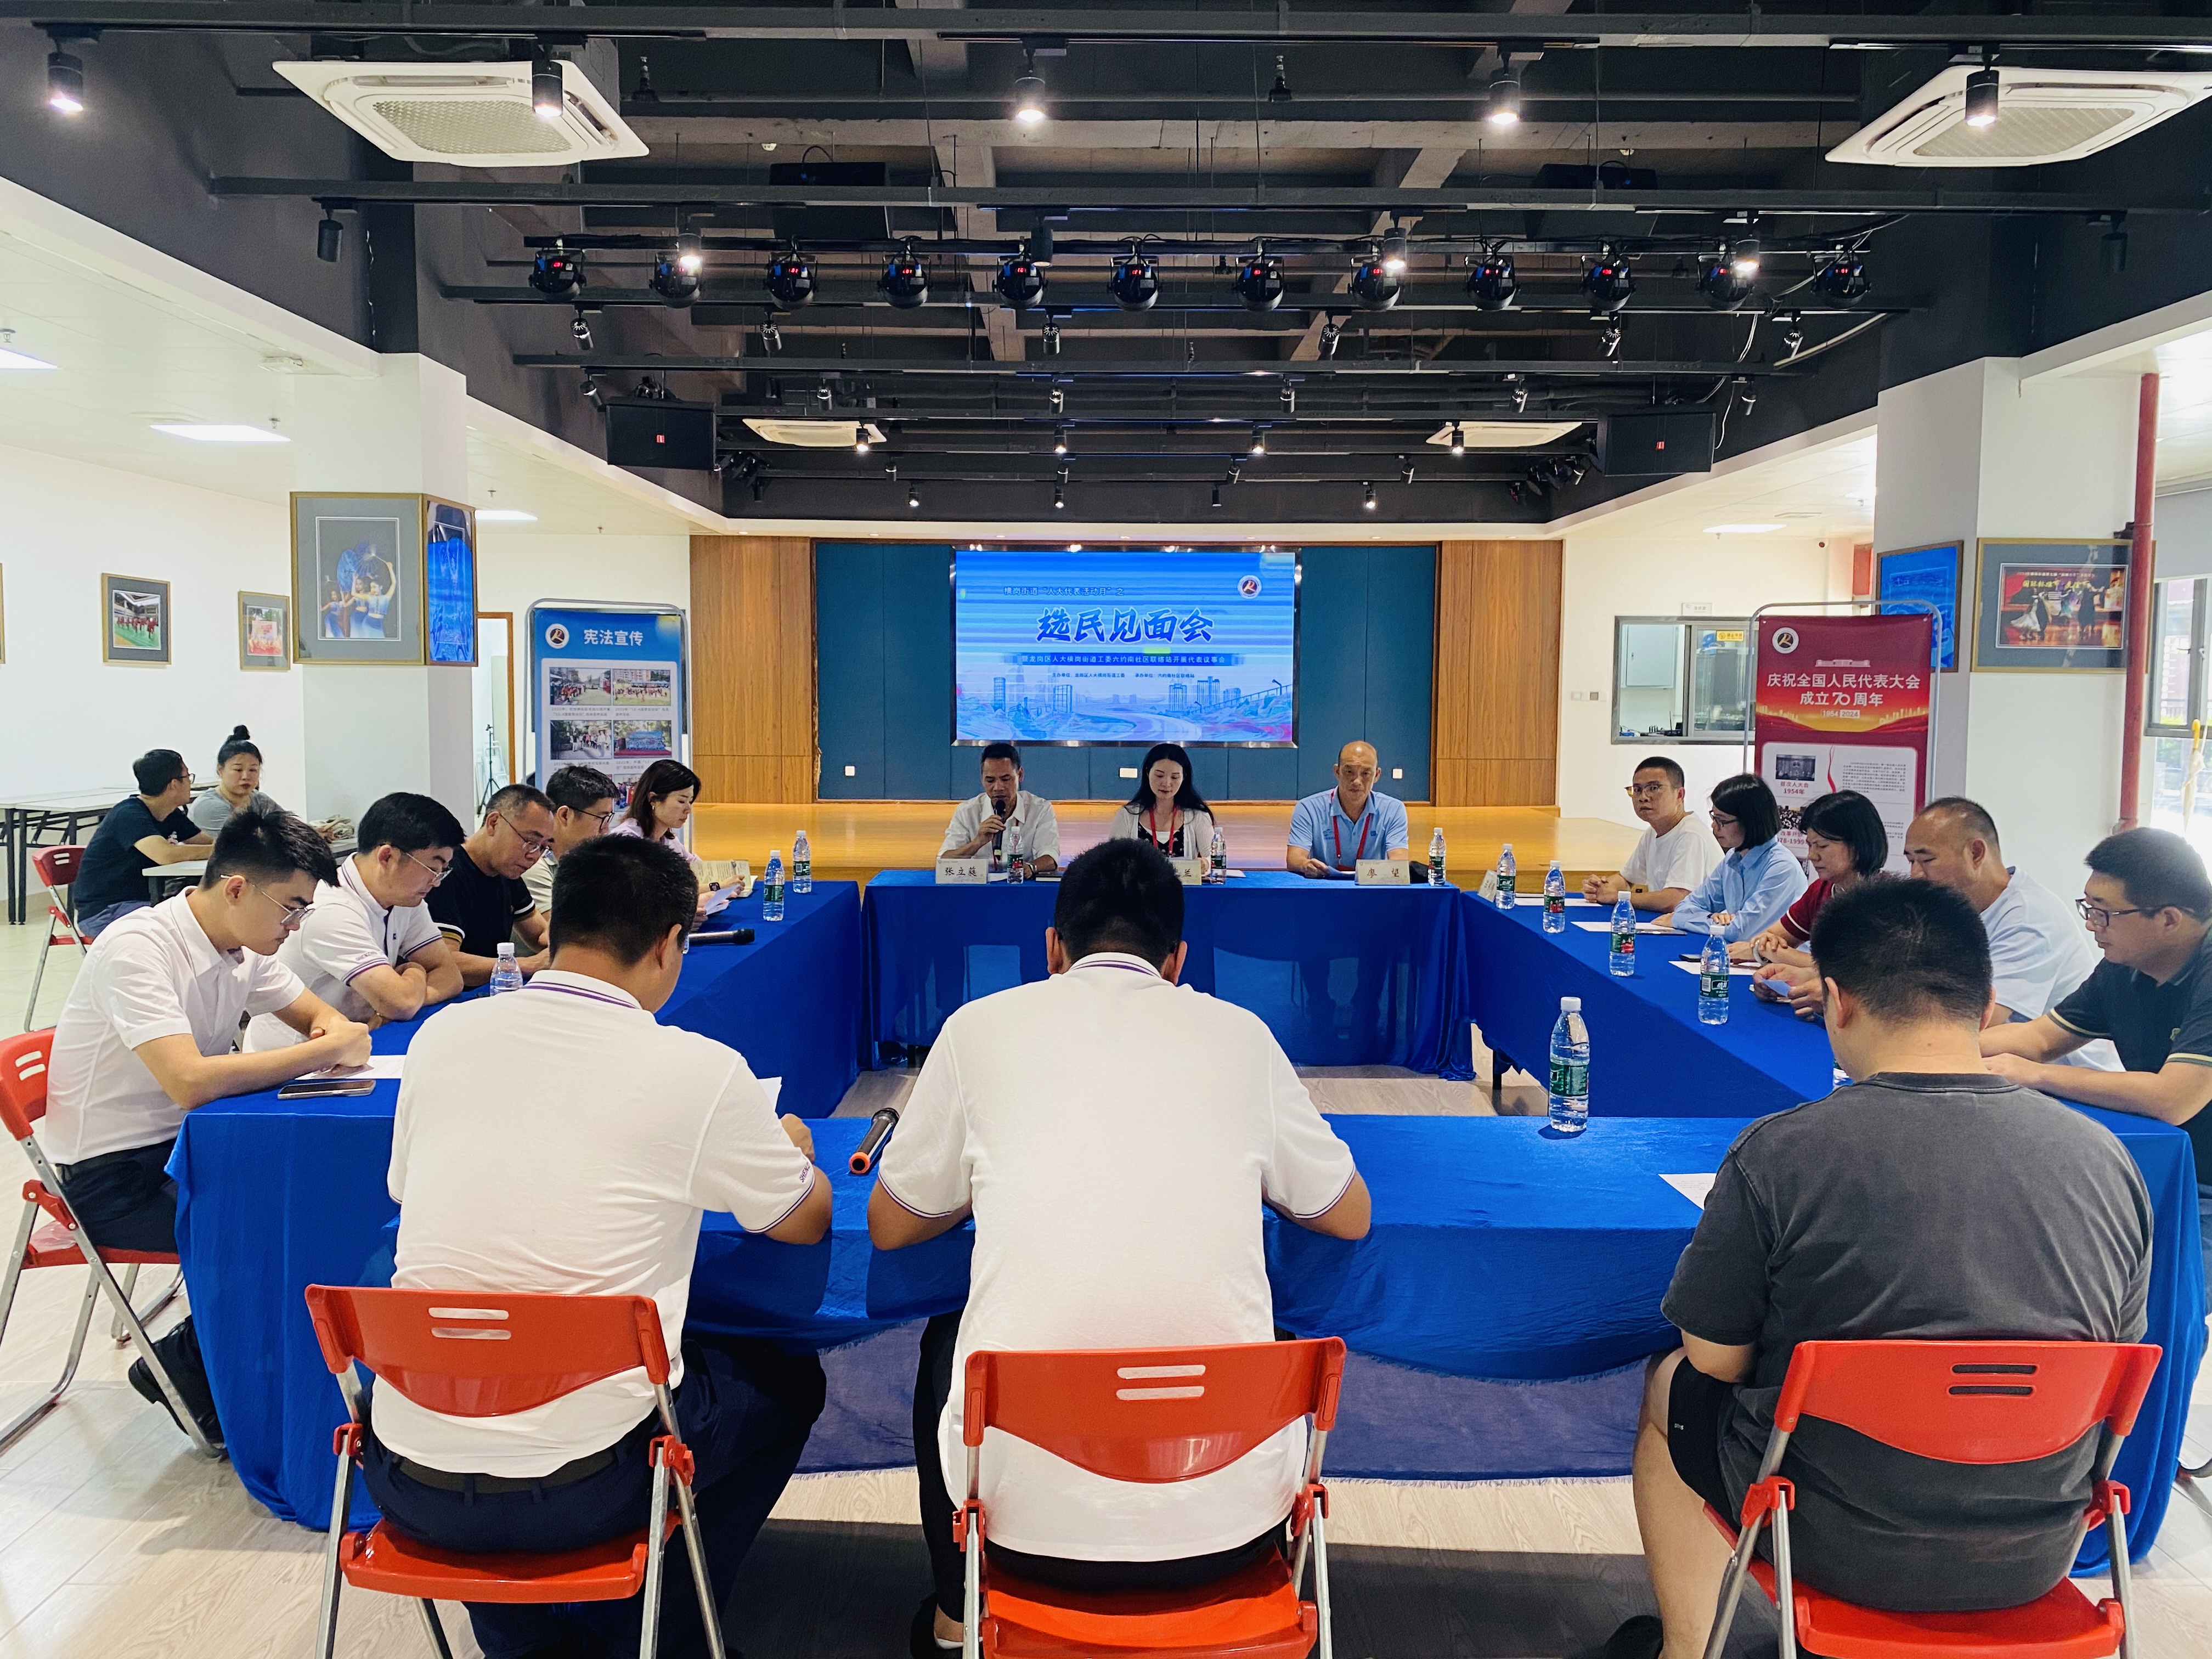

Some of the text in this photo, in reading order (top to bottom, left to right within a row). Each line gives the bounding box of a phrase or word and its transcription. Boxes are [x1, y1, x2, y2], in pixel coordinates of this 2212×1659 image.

[1035, 607, 1215, 644] 选民见面会
[584, 629, 644, 646] 宪法宣传
[1767, 673, 1921, 689] 庆祝全国人民代表大会
[1800, 692, 1884, 707] 成立70周年
